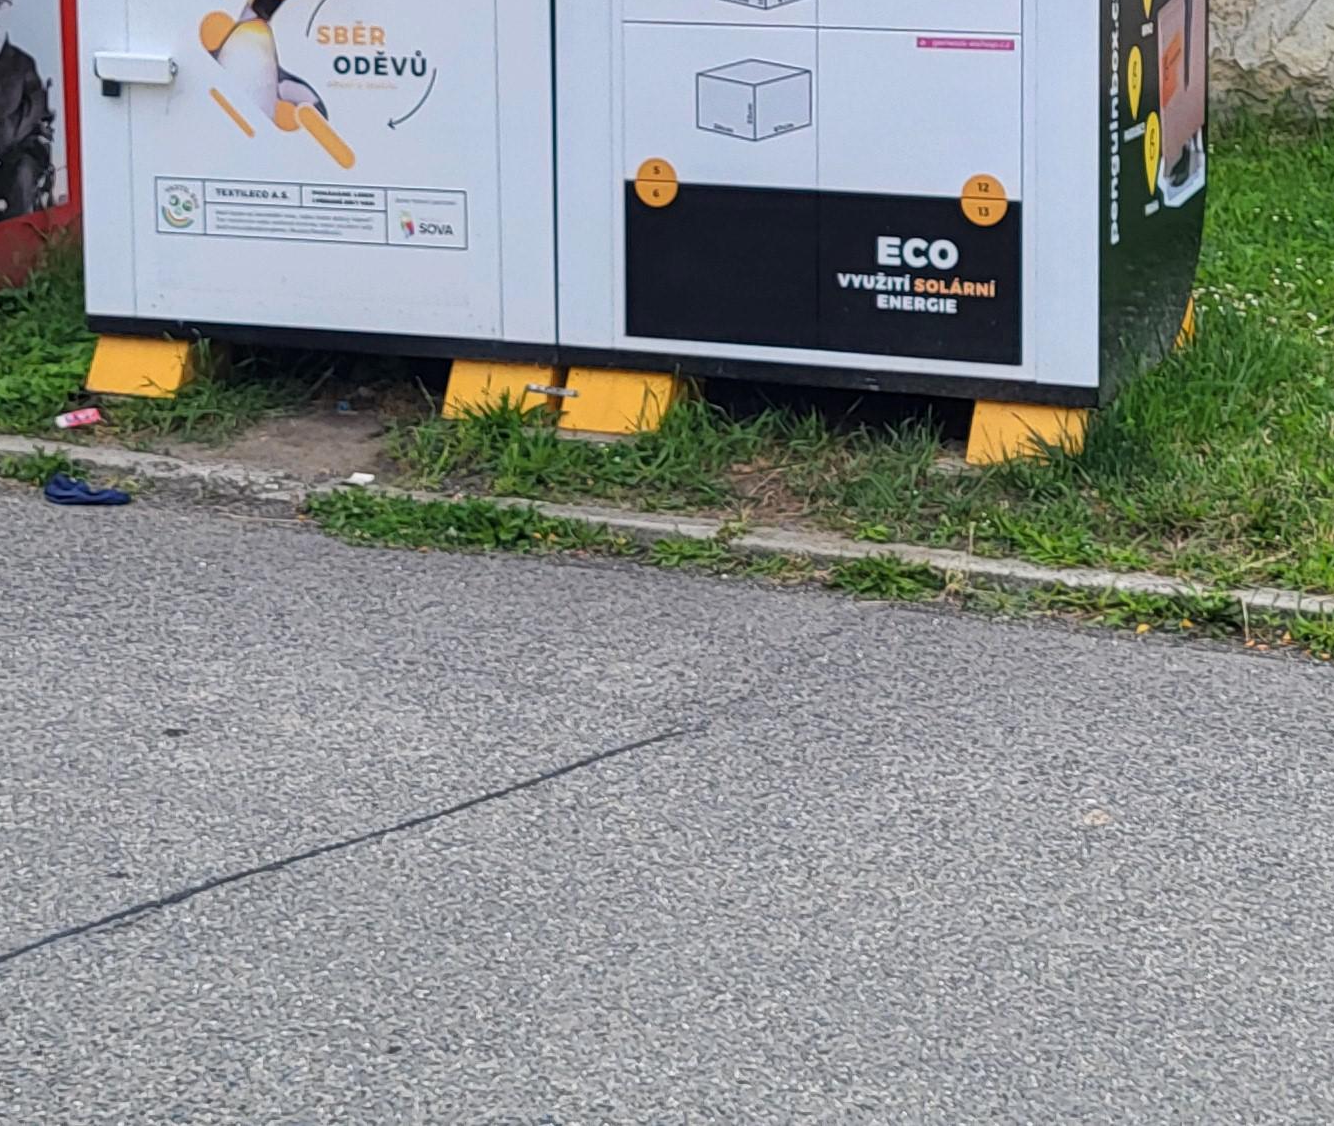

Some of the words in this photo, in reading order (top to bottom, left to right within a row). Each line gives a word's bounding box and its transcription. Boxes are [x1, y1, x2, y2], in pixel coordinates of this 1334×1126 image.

[317, 21, 385, 46] SBĚR
[333, 50, 427, 77] ODĚVŮ
[977, 182, 990, 193] 12
[977, 206, 990, 218] 13
[417, 222, 455, 235] SOVA
[876, 235, 959, 271] ECO
[836, 271, 911, 293] VYUŽITÍ
[913, 277, 997, 299] SOLÁRNÍ
[876, 294, 958, 314] ENERGIE
